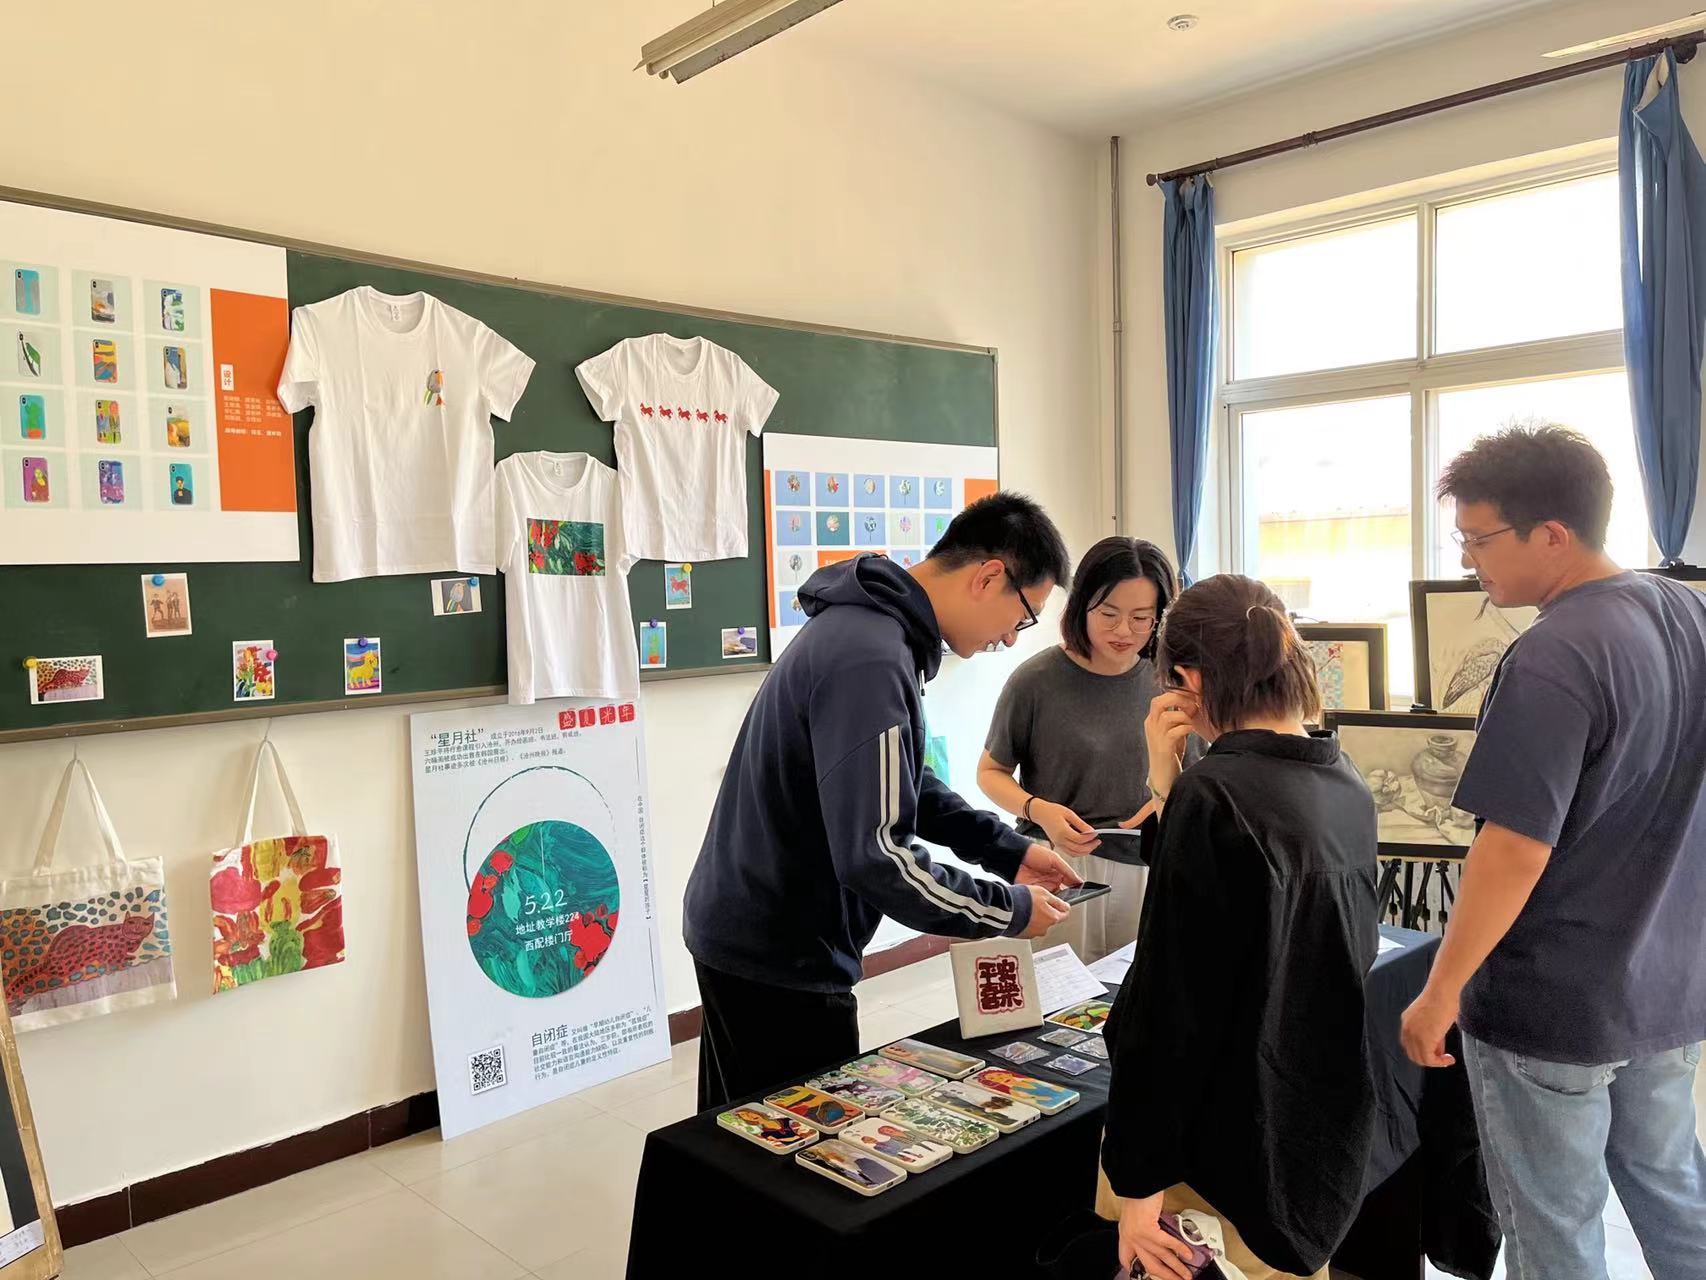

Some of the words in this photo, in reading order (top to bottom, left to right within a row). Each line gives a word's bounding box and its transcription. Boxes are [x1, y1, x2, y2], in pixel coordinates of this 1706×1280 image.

[431, 728, 484, 748] “星月社”
[525, 889, 568, 915] 5.22
[516, 911, 579, 935] 地址教学楼224
[524, 930, 573, 952] 西配楼门厅
[531, 1024, 568, 1047] 自闭症
